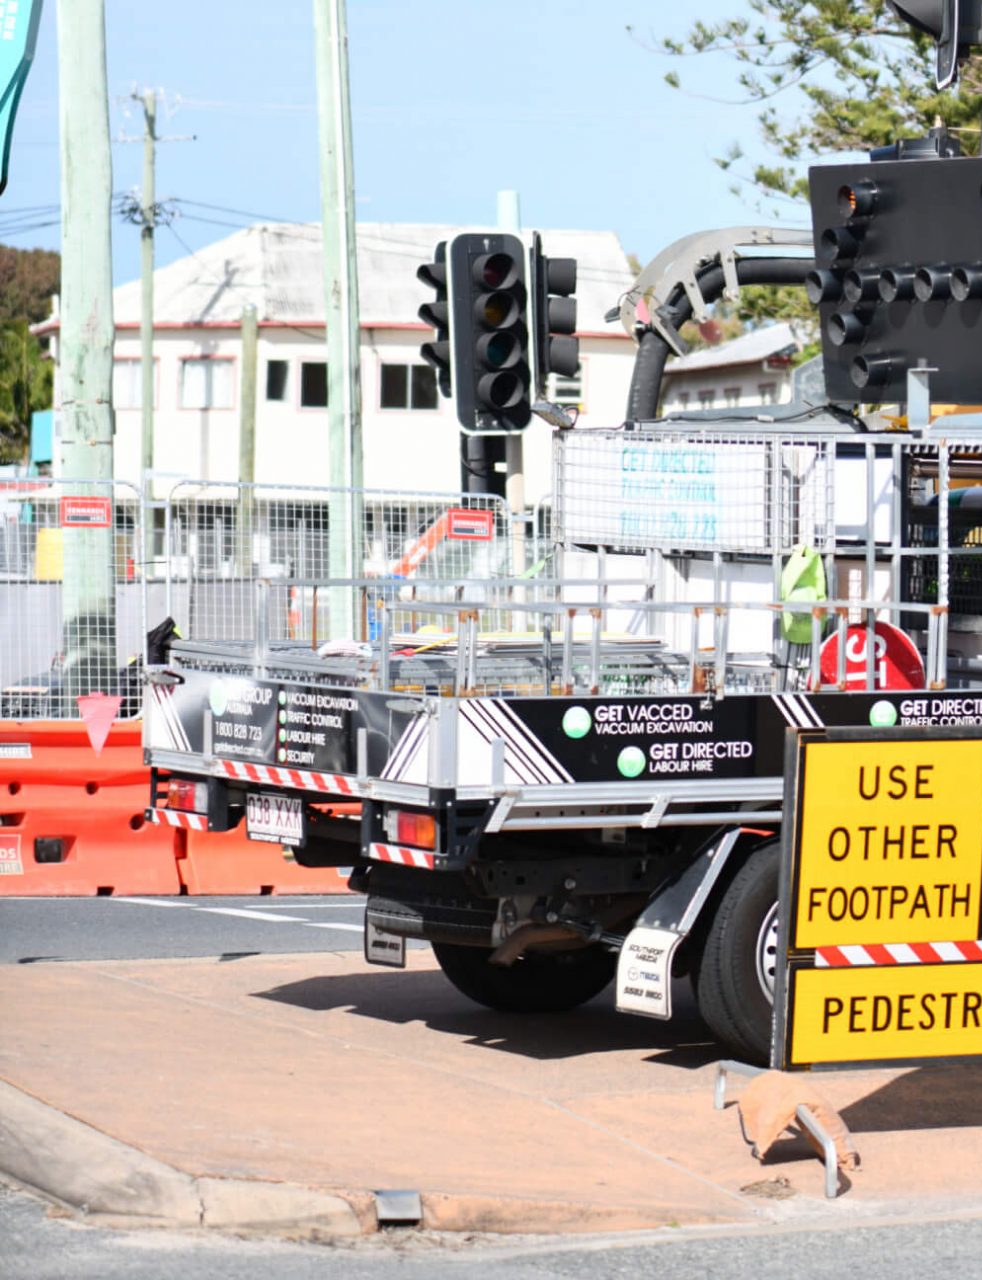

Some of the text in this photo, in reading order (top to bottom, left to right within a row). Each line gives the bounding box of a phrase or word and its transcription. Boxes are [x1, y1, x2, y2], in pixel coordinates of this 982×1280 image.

[594, 704, 693, 722] GET VACCED
[900, 700, 928, 715] GET
[311, 713, 343, 729] CONTROL
[594, 721, 713, 735] VACCUM EXCAVATION
[287, 733, 312, 744] LABOUR
[286, 751, 315, 764] SECURITY
[650, 741, 753, 760] GET DIRECTED
[649, 760, 713, 773] LABOUR HIRE
[858, 764, 935, 800] USE
[248, 796, 271, 824] 038
[827, 824, 958, 862] OTHER
[808, 883, 972, 922] FOOTPATH
